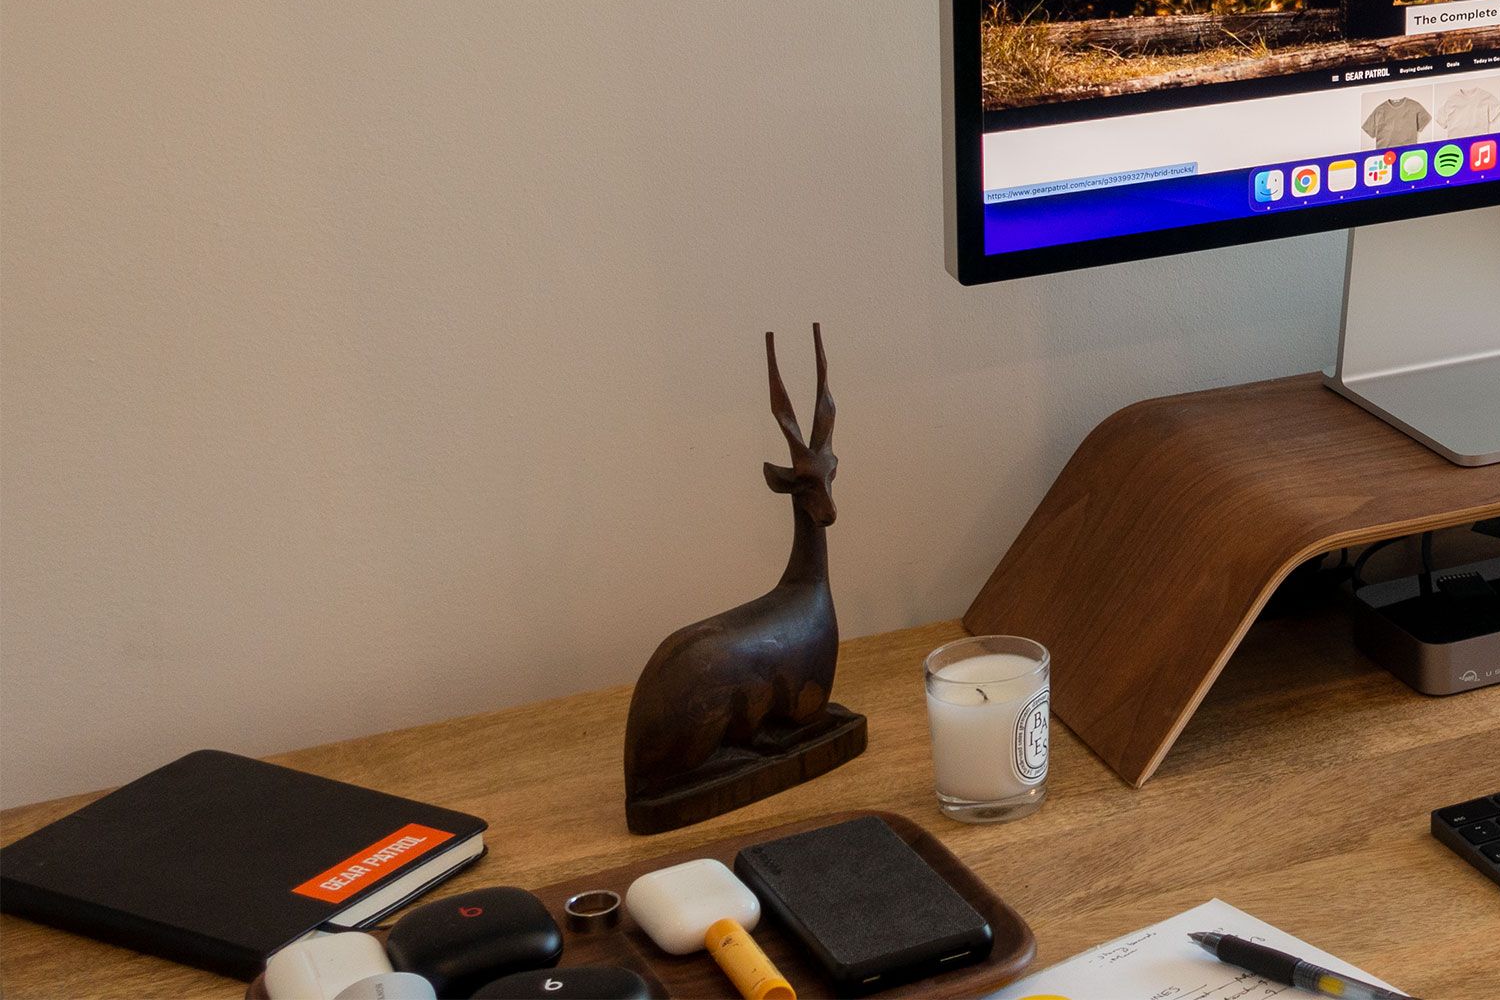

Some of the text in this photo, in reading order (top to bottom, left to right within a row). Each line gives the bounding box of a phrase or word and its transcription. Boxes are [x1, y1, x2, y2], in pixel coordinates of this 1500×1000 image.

[1413, 14, 1437, 27] The
[1440, 7, 1498, 25] Complete
[1345, 67, 1391, 82] GEAR PATROL
[320, 835, 428, 891] GEAR PATROL
